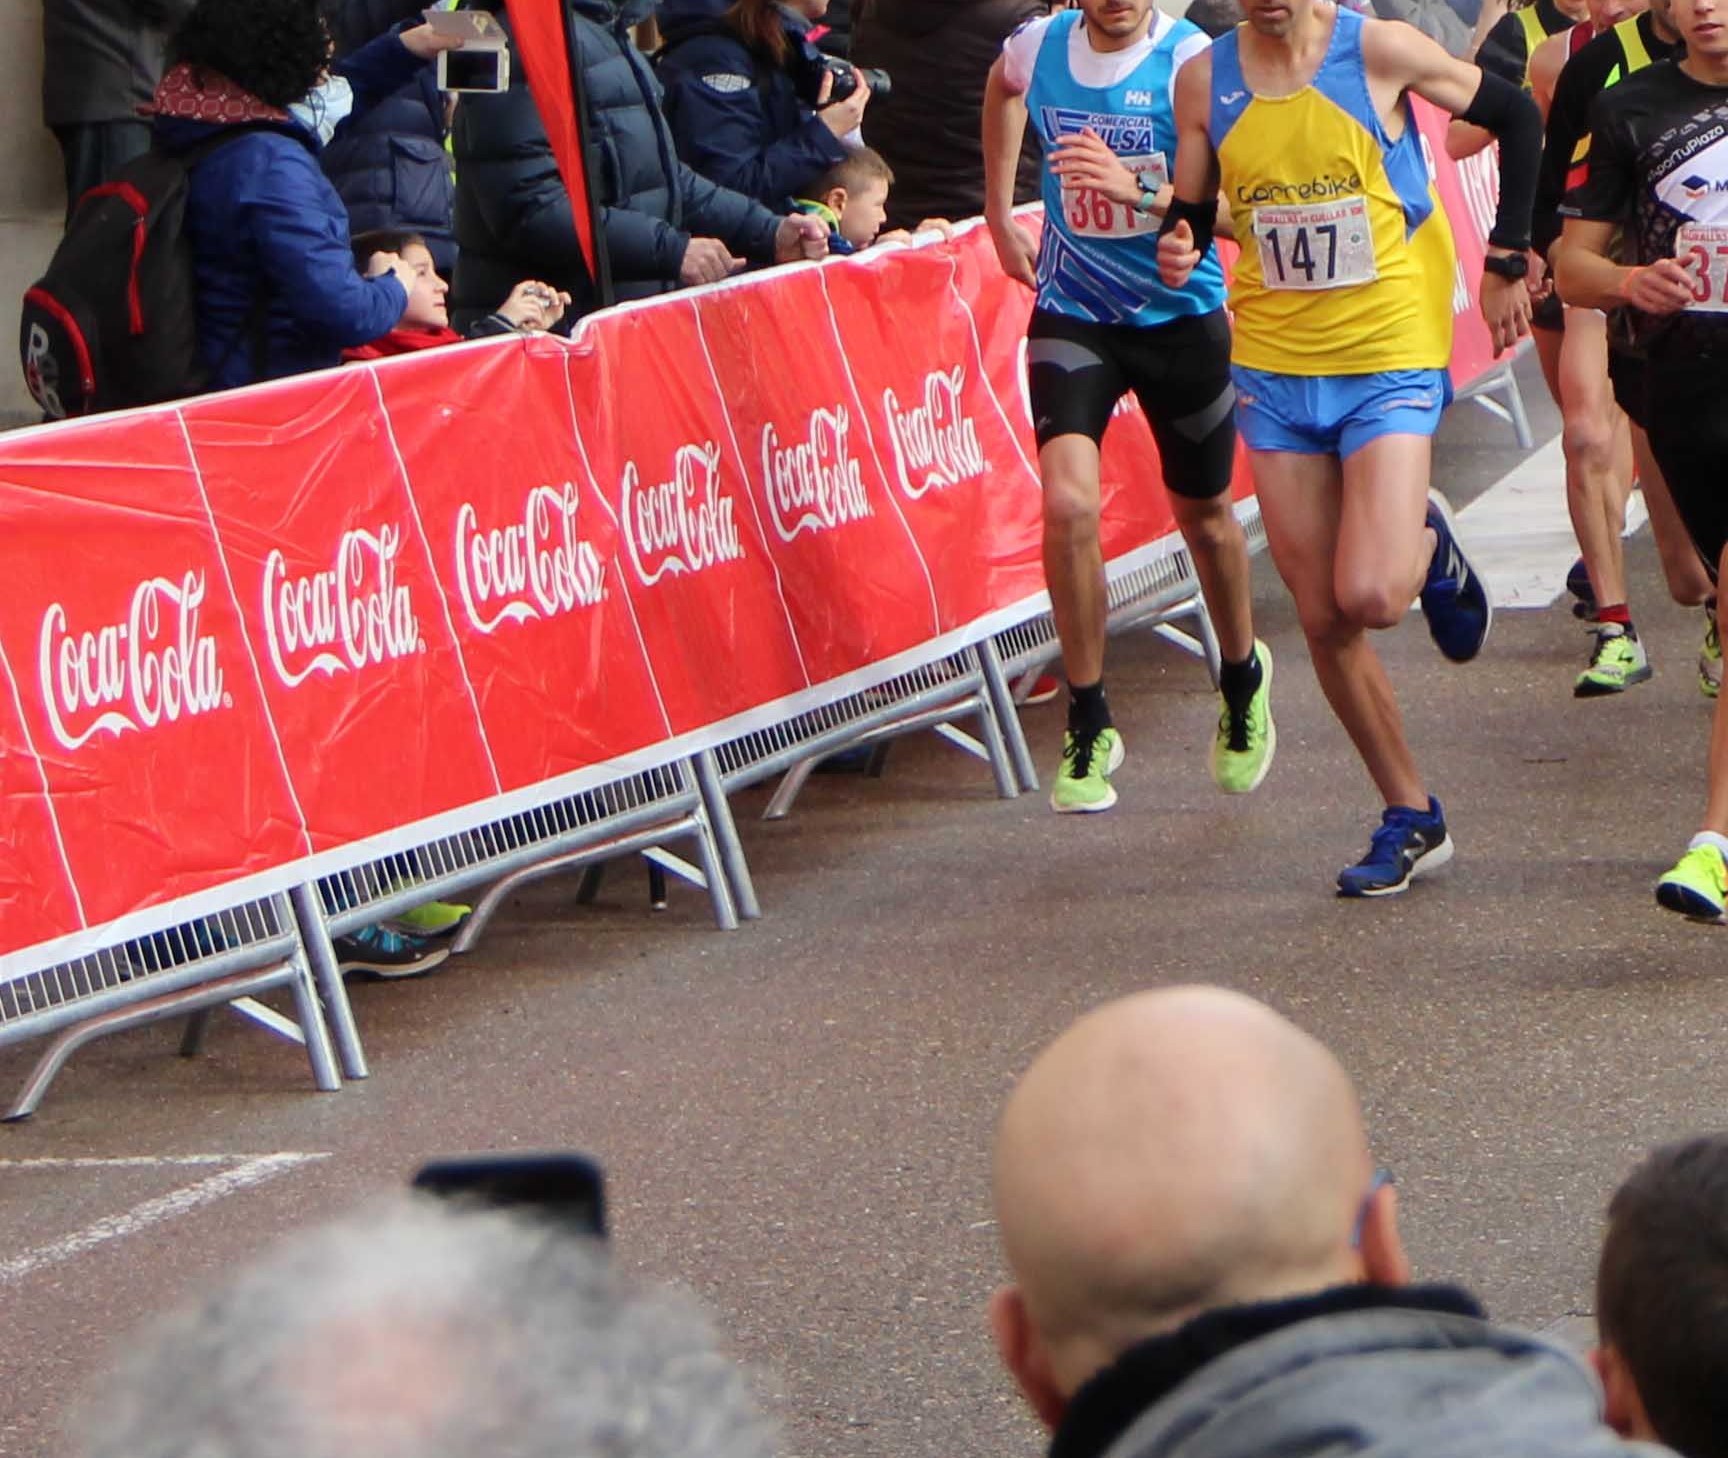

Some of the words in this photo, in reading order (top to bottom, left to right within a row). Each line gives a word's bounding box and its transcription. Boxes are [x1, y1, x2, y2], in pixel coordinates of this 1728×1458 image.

[1090, 114, 1152, 129] COMERCIAL
[1265, 225, 1339, 283] 147
[761, 404, 868, 541] Coca-Cola
[883, 363, 986, 501] Coca-Cola
[453, 479, 602, 634] Coca-Cola
[621, 438, 739, 587] Coca-Cola
[38, 568, 224, 750] Coca-Cola
[261, 522, 419, 688] Coca-Cola
